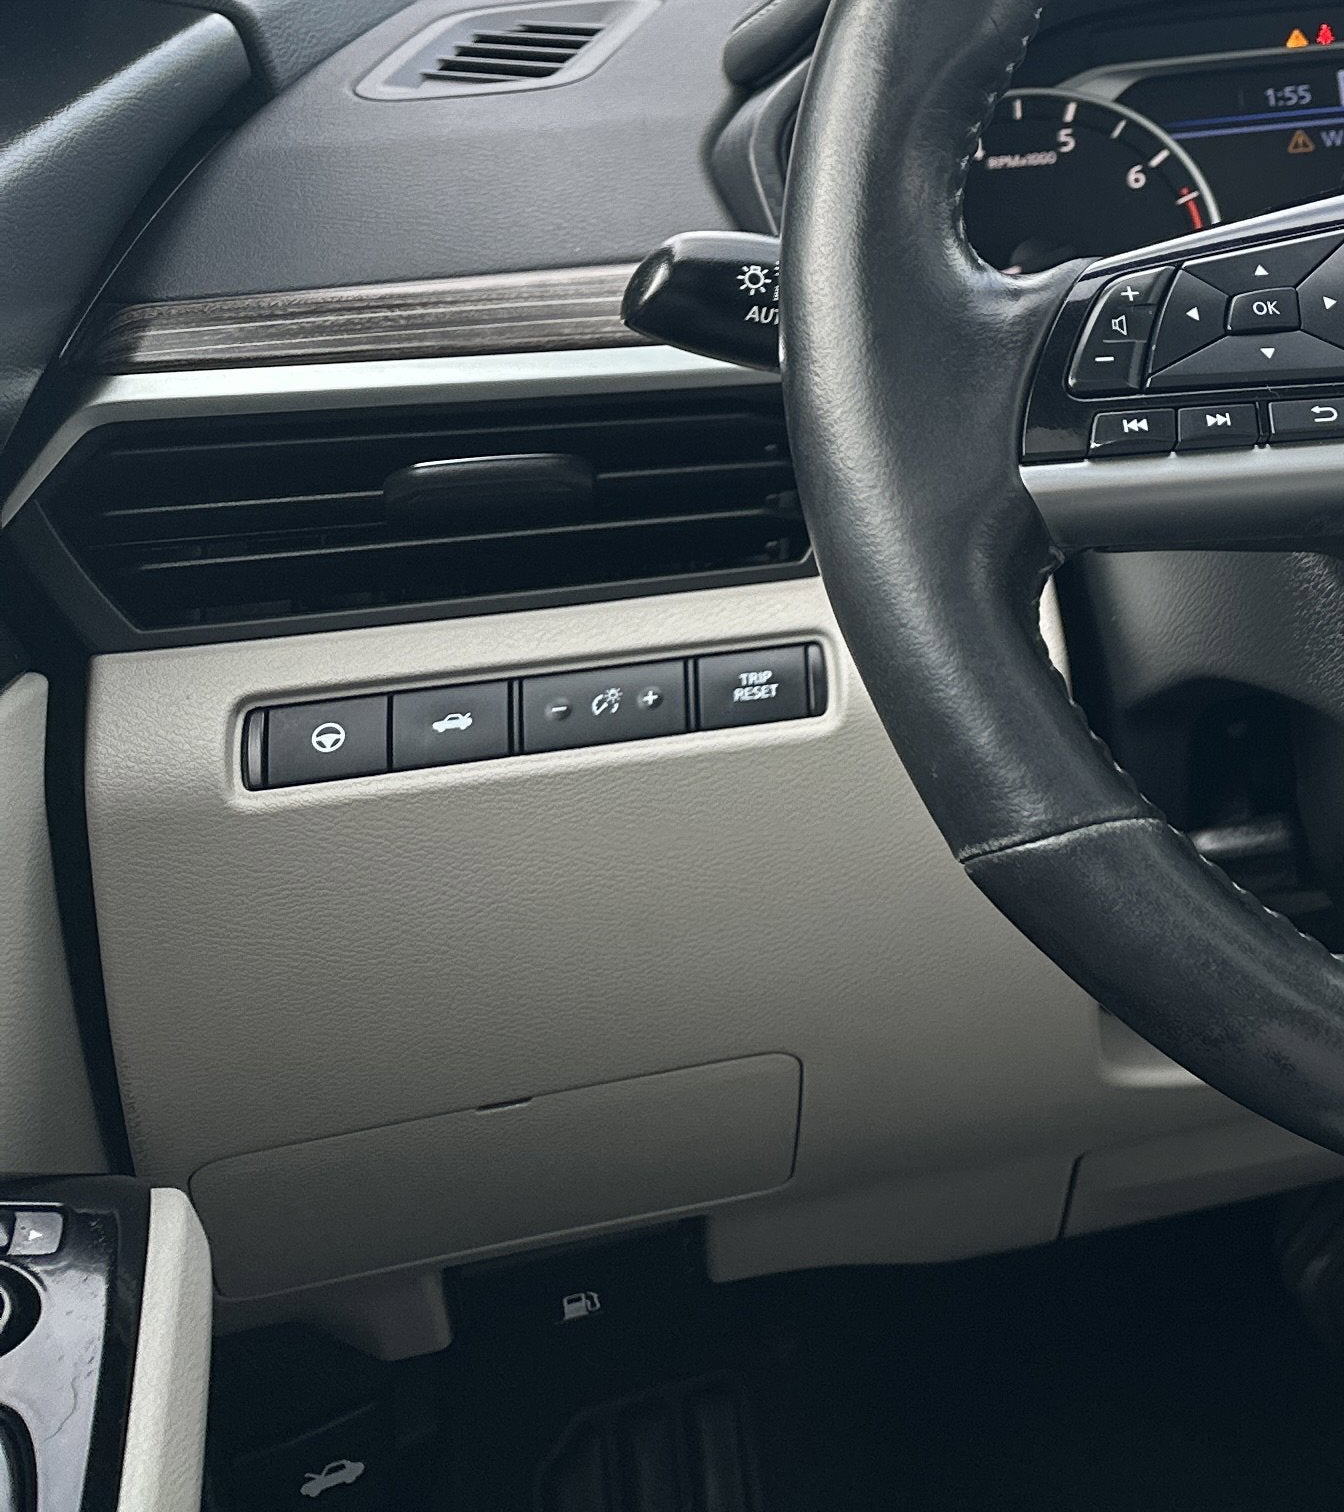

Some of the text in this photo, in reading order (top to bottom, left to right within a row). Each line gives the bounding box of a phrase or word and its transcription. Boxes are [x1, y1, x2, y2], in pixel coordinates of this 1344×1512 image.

[1265, 84, 1313, 107] 1:55
[1056, 127, 1076, 153] 5
[1126, 164, 1147, 189] 6
[744, 305, 779, 325] AUT
[1252, 300, 1280, 316] OK
[738, 670, 773, 686] TRIP
[733, 683, 779, 702] RESET
